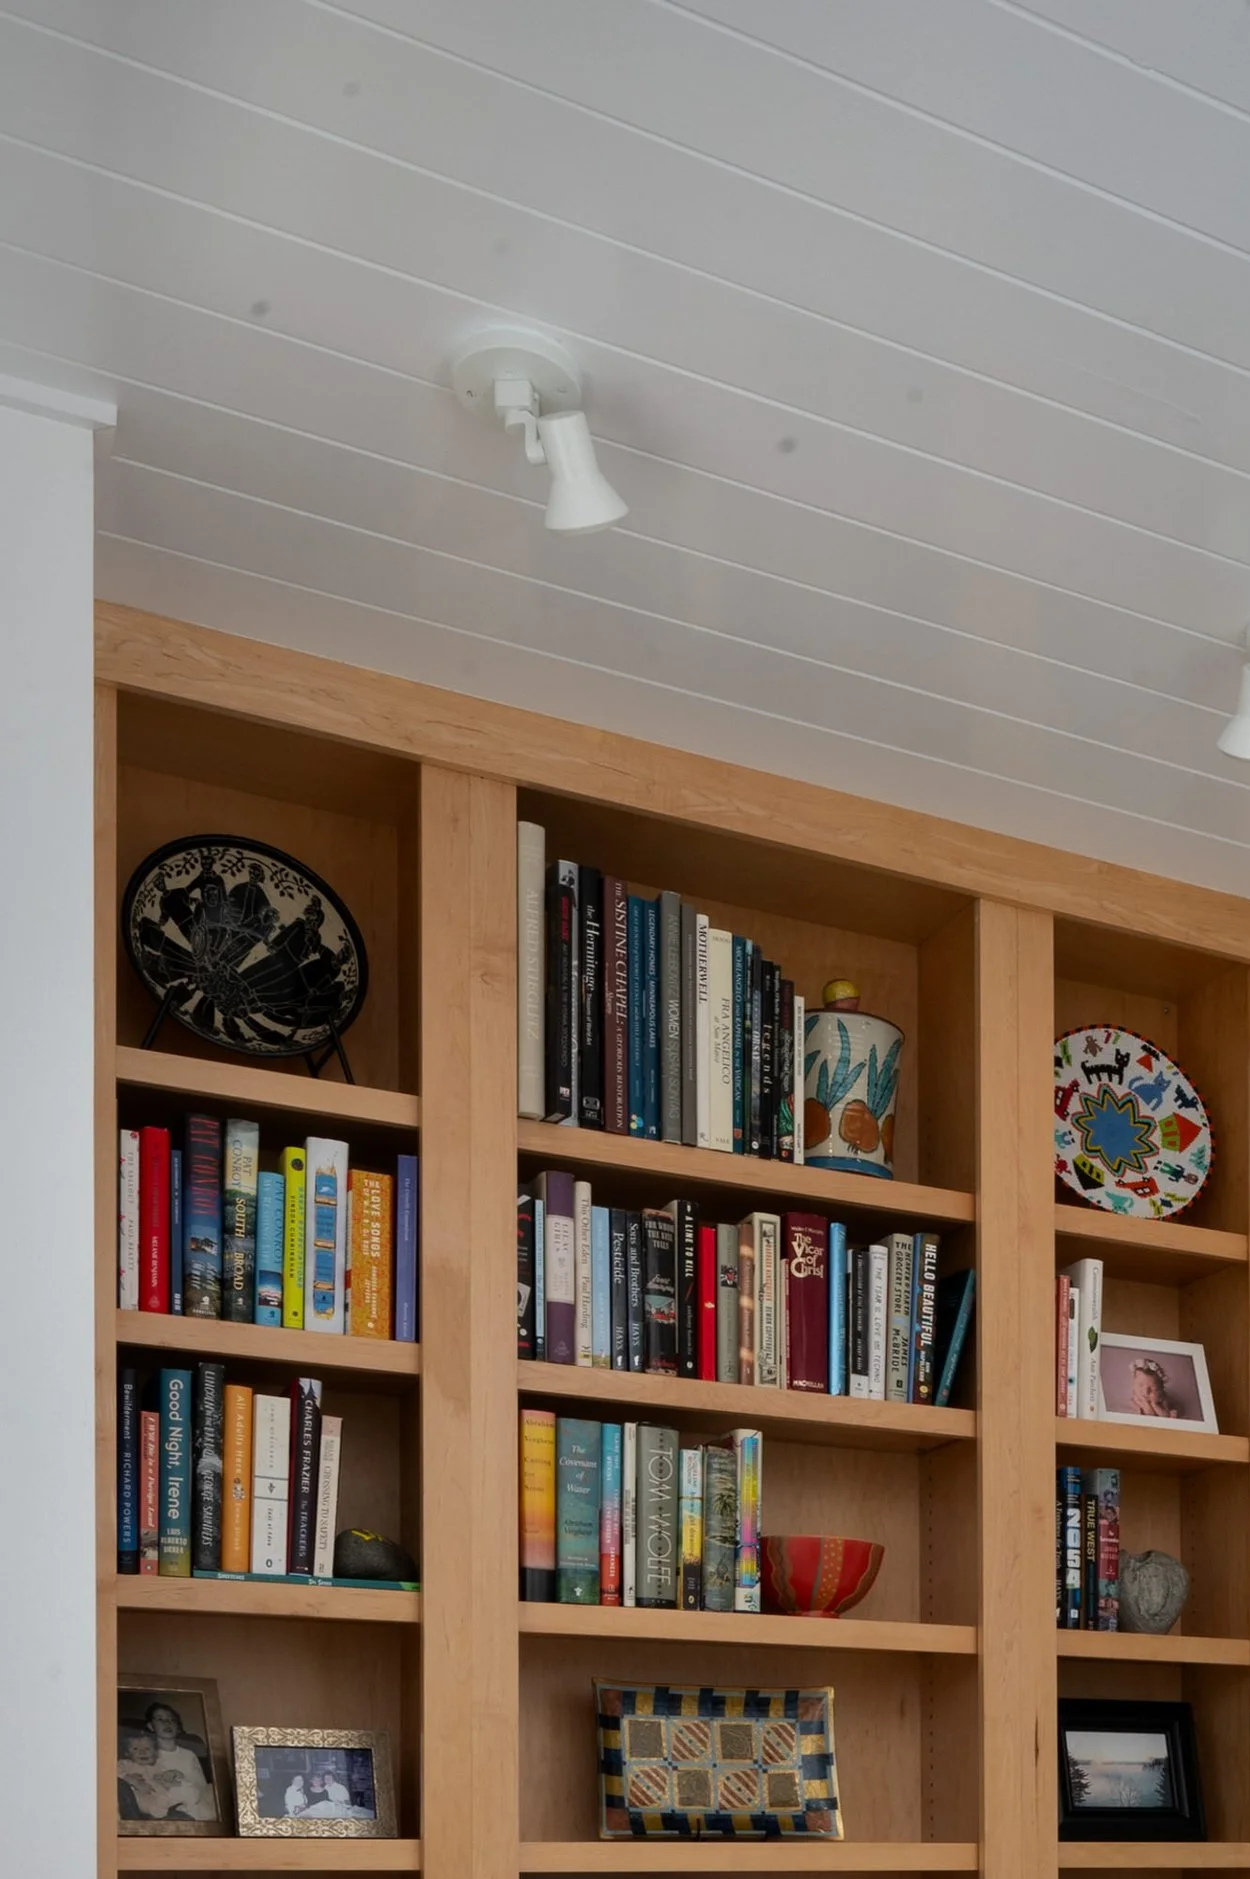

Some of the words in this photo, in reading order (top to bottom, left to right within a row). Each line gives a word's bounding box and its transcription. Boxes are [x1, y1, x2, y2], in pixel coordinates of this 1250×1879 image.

[586, 905, 595, 920] the
[615, 900, 627, 959] SISTINE
[647, 910, 656, 949] LEGENDARY
[584, 920, 599, 992] Hermitage
[647, 950, 656, 976] HOMES
[698, 924, 709, 1004] MOTHERWELL
[615, 961, 627, 1025] CHAPEL:
[647, 981, 656, 1027] MINNEAPOLIS
[720, 998, 731, 1021] FRA
[666, 1000, 680, 1040] WOMEN
[647, 1028, 656, 1049] LAKES
[720, 1023, 731, 1084] ANGELICO
[762, 1024, 773, 1094] legends
[231, 1139, 243, 1188] CONROY
[243, 1156, 253, 1176] PAT
[234, 1197, 246, 1237] SOUTH
[371, 1189, 381, 1216] LOVE
[580, 1198, 590, 1215] This
[371, 1222, 381, 1258] SONGS
[580, 1217, 590, 1241] Other
[630, 1222, 640, 1245] Sons
[685, 1224, 694, 1243] LINE
[795, 1233, 812, 1244] The
[896, 1241, 911, 1251] THE
[580, 1243, 590, 1264] Eden
[614, 1232, 625, 1285] Pesticide
[630, 1247, 640, 1265] and
[685, 1247, 694, 1256] TO
[792, 1241, 824, 1258] Vicar
[806, 1255, 817, 1264] of
[923, 1243, 937, 1281] HELLO
[234, 1252, 246, 1290] BROAD
[685, 1260, 694, 1278] KILL
[790, 1257, 824, 1278] Christ
[894, 1250, 903, 1286] GROCERY
[580, 1276, 590, 1294] Paul
[630, 1267, 640, 1307] Brothers
[894, 1287, 903, 1314] STORE
[580, 1295, 590, 1329] Harding
[920, 1284, 935, 1347] BEAUTIFUL
[616, 1326, 624, 1350] HAYS
[632, 1323, 640, 1346] HAYS
[891, 1328, 901, 1373] McBRIDE
[901, 1336, 909, 1367] JAMES
[123, 1384, 132, 1439] Bewilderment
[168, 1379, 184, 1421] Good
[303, 1399, 314, 1446] CHARLES
[166, 1426, 184, 1469] Night,
[559, 1456, 598, 1469] Covenant
[573, 1444, 587, 1454] The
[123, 1452, 132, 1498] RICHARD
[300, 1449, 313, 1494] FRAZIER
[321, 1465, 333, 1506] CROSSING
[576, 1471, 585, 1482] of
[647, 1447, 673, 1502] TOM
[168, 1476, 184, 1519] Irene
[567, 1483, 592, 1495] Water
[123, 1502, 132, 1543] POWERS
[321, 1507, 330, 1517] TO
[1086, 1499, 1095, 1528] TRUE
[298, 1511, 308, 1557] TRACKERS
[318, 1519, 330, 1551] SAFETY
[647, 1512, 673, 1587] WOLFE
[1066, 1507, 1081, 1586] 2054
[1086, 1530, 1095, 1562] WEST
